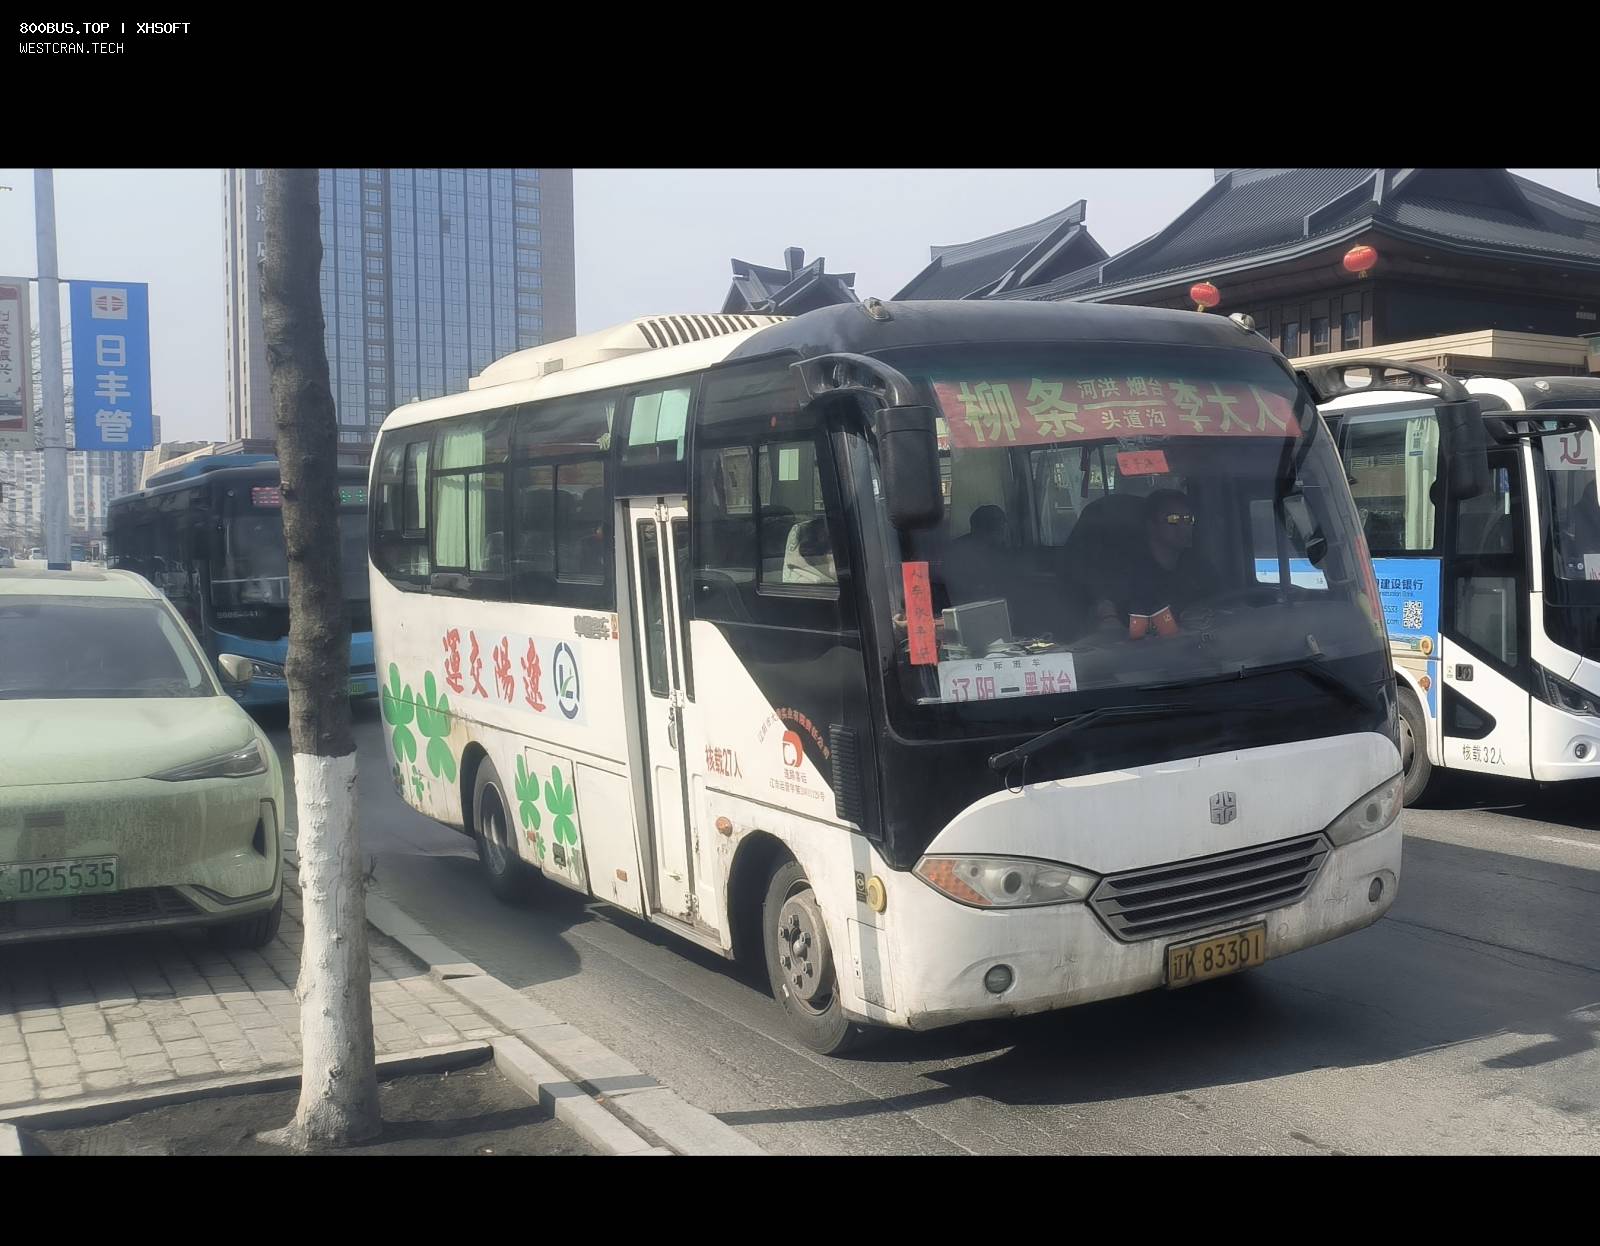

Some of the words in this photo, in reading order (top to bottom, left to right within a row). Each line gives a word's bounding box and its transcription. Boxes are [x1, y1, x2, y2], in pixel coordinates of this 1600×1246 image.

[94, 333, 133, 443] 日丰管
[1167, 378, 1288, 433] 李大人
[956, 378, 1085, 443] 柳条
[1100, 408, 1168, 430] 头道沟
[1559, 430, 1589, 465] 辽
[1376, 578, 1425, 591] 建设银行
[704, 743, 743, 780] 核载27人
[1462, 744, 1506, 766] 核载32人
